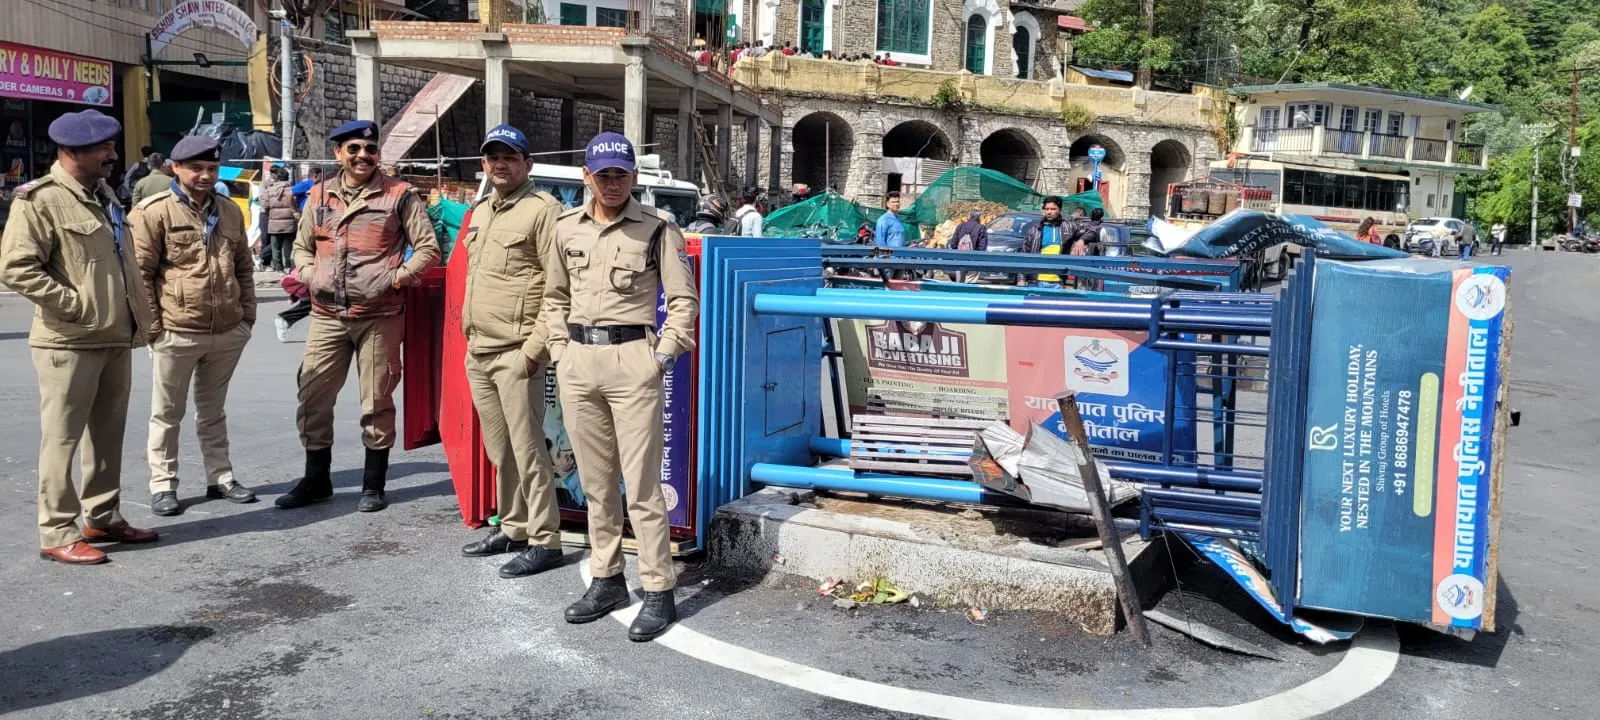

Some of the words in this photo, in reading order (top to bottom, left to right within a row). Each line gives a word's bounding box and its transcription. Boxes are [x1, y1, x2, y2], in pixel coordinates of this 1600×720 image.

[151, 13, 174, 40] BISHOP
[175, 1, 200, 19] SHAW
[202, 0, 225, 14] INTER
[21, 52, 30, 76] &
[34, 53, 71, 81] DAILY
[73, 60, 110, 86] NEEDS
[19, 83, 63, 97] CAMERAS
[487, 129, 517, 140] POLICE
[592, 141, 628, 156] POLICE
[874, 347, 962, 367] ADVERTISING
[1455, 326, 1489, 412] नैनीताल
[882, 379, 914, 388] PRINTING
[1346, 343, 1364, 403] HOLIDAY,
[1361, 349, 1378, 428] MOUNTAINS
[938, 386, 977, 395] HOARDING
[1380, 390, 1391, 418] Hotels
[1343, 406, 1357, 457] LUXURY
[1379, 418, 1388, 430] of
[1394, 389, 1412, 469] 8686947478
[1360, 429, 1372, 457] THE
[1377, 431, 1390, 460] Group
[1452, 415, 1486, 477] पुलिस
[1341, 459, 1354, 494] NEXT
[1358, 459, 1371, 474] IN
[1375, 461, 1388, 492] Shivraj
[1393, 472, 1407, 496] +91
[1339, 496, 1353, 532] YOUR
[1356, 476, 1370, 529] NESTED
[1453, 481, 1477, 569] यातायात
